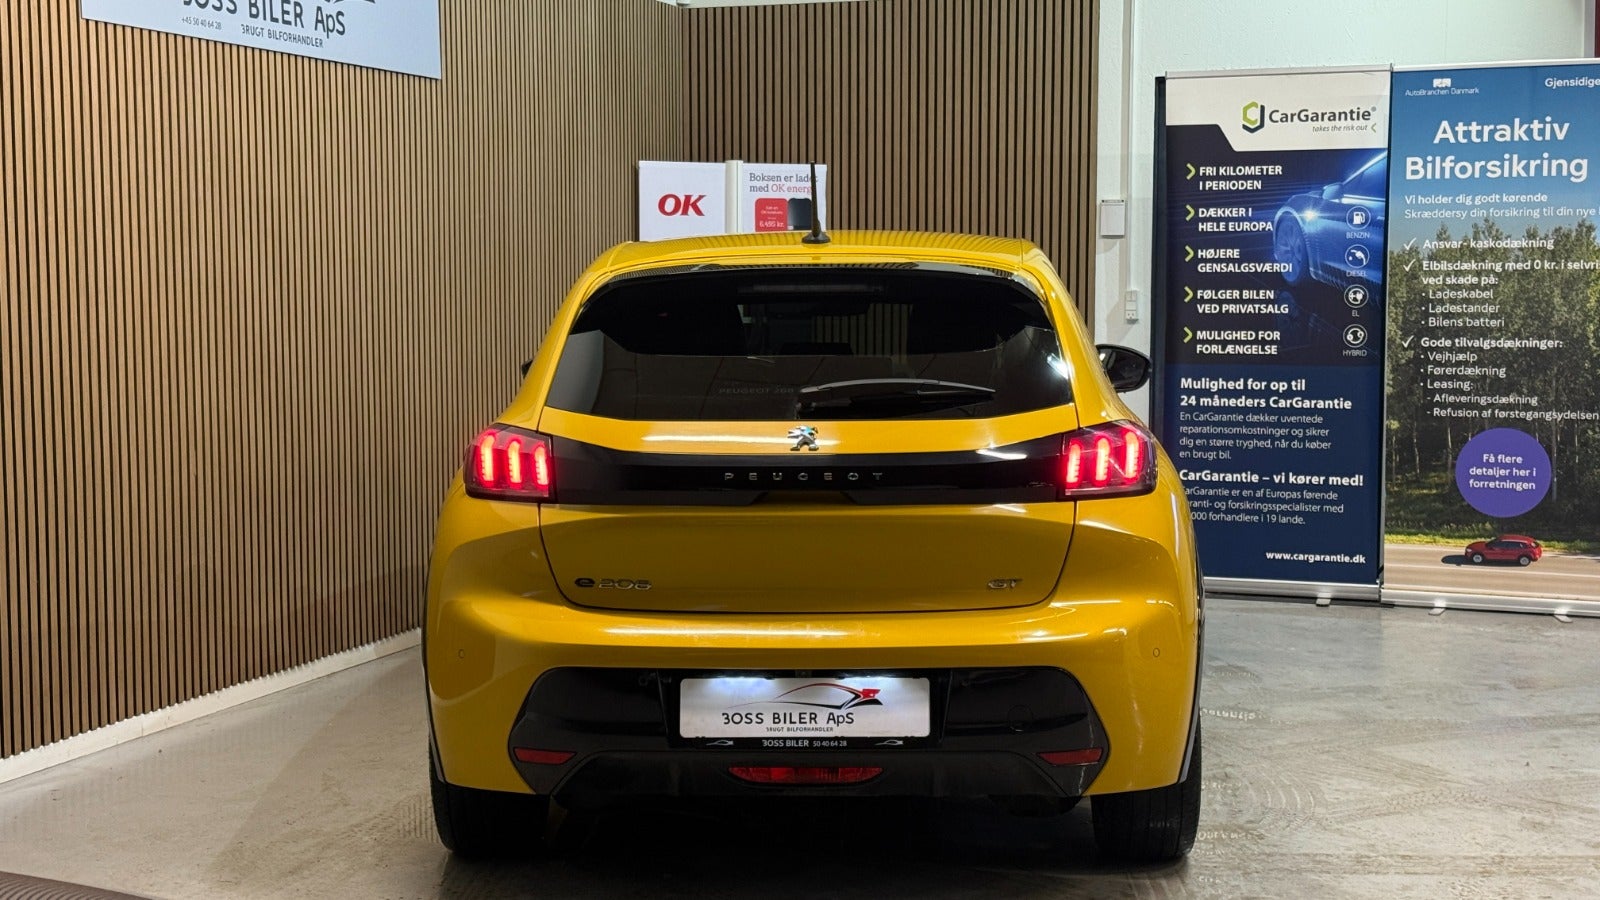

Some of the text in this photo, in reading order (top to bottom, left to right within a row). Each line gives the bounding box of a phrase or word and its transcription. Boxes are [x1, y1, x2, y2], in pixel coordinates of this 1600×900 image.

[249, 0, 304, 28] BILER
[315, 6, 345, 38] ApS
[268, 29, 323, 48] BILFORHANDLER
[1545, 77, 1600, 88] Gjensidige
[1269, 107, 1370, 123] CarGarantie
[1433, 116, 1569, 144] Attraktiv
[1200, 164, 1282, 176] FRI KILOMETER
[1405, 153, 1588, 183] Bilforsikring
[749, 173, 781, 182] Boksen
[796, 174, 818, 182] lad
[750, 184, 812, 194] med OK energ
[1200, 180, 1262, 190] I PERIODEN
[658, 194, 706, 216] OK
[1405, 193, 1547, 207] Vi holder dig godt kørende
[1199, 208, 1252, 217] DÆKKER I
[1405, 208, 1467, 219] Skræddersy
[1470, 208, 1486, 217] din
[1489, 208, 1540, 217] forsikring
[1543, 207, 1554, 216] til
[1556, 207, 1573, 216] din
[1576, 209, 1595, 218] nye
[1198, 222, 1273, 232] HELE EUROPA
[1470, 238, 1554, 249] kaskodækning
[1198, 248, 1240, 259] HØJERE
[1198, 262, 1292, 273] GENSALGSVÆRDI
[1423, 261, 1502, 273] Elbilsdækning
[1505, 261, 1530, 270] med
[1533, 261, 1540, 270] 0
[1544, 261, 1558, 270] kr.
[1561, 260, 1564, 270] i
[1422, 276, 1498, 287] ved skade på:
[1198, 289, 1274, 300] FØLGER BILEN
[1429, 289, 1493, 299] Ladeskabel
[1197, 304, 1288, 314] VED PRIVATSALG
[1429, 303, 1500, 313] Ladestander
[1429, 317, 1504, 327] Bilens batteri
[1196, 330, 1280, 341] MULIGHED FOR
[1421, 337, 1563, 349] Gode tilvalgsdækninger:
[1196, 344, 1277, 354] FORLÆNGELSE
[1428, 351, 1477, 363] Vejhjælp
[1427, 365, 1506, 378] Førerdækning
[1181, 378, 1306, 392] Mulighed for op til
[1427, 380, 1473, 391] Leasing:
[1180, 395, 1352, 409] 24 måneders CarGarantie
[1434, 394, 1537, 406] Afleveringsdækning
[1193, 413, 1244, 422] CarGarantie
[1246, 413, 1278, 423] dækker
[1281, 414, 1323, 424] uventede
[1434, 408, 1599, 421] Refusion af førstegangsydelsen
[1180, 425, 1329, 437] reparationsomkostninger og sikrer
[1180, 438, 1193, 447] dig
[1209, 439, 1233, 447] større
[1236, 439, 1272, 449] tryghed,
[1275, 439, 1290, 448] når
[1292, 440, 1303, 449] du
[1306, 440, 1331, 449] køber
[1193, 450, 1217, 460] brugt
[1219, 450, 1231, 460] bil.
[1482, 454, 1523, 464] Få flere
[724, 473, 883, 481] PEUGEOT
[1180, 470, 1363, 486] CarGarantie vi kører med!
[1469, 467, 1536, 478] detaljer her i
[1469, 480, 1536, 491] forretningen
[1183, 487, 1229, 496] arGarantie
[1255, 489, 1264, 498] af
[1266, 489, 1301, 500] Europas
[1303, 491, 1338, 500] førende
[1214, 503, 1225, 511] og
[1228, 501, 1321, 514] forsikringsspecialister
[1323, 504, 1343, 513] med
[1209, 513, 1259, 523] forhandlere
[1266, 515, 1276, 523] 19
[1279, 515, 1305, 524] lande.
[1266, 552, 1366, 564] www.cargarantie.dk
[988, 578, 1023, 589] GT
[773, 712, 817, 724] BILER
[827, 713, 854, 727] ApS
